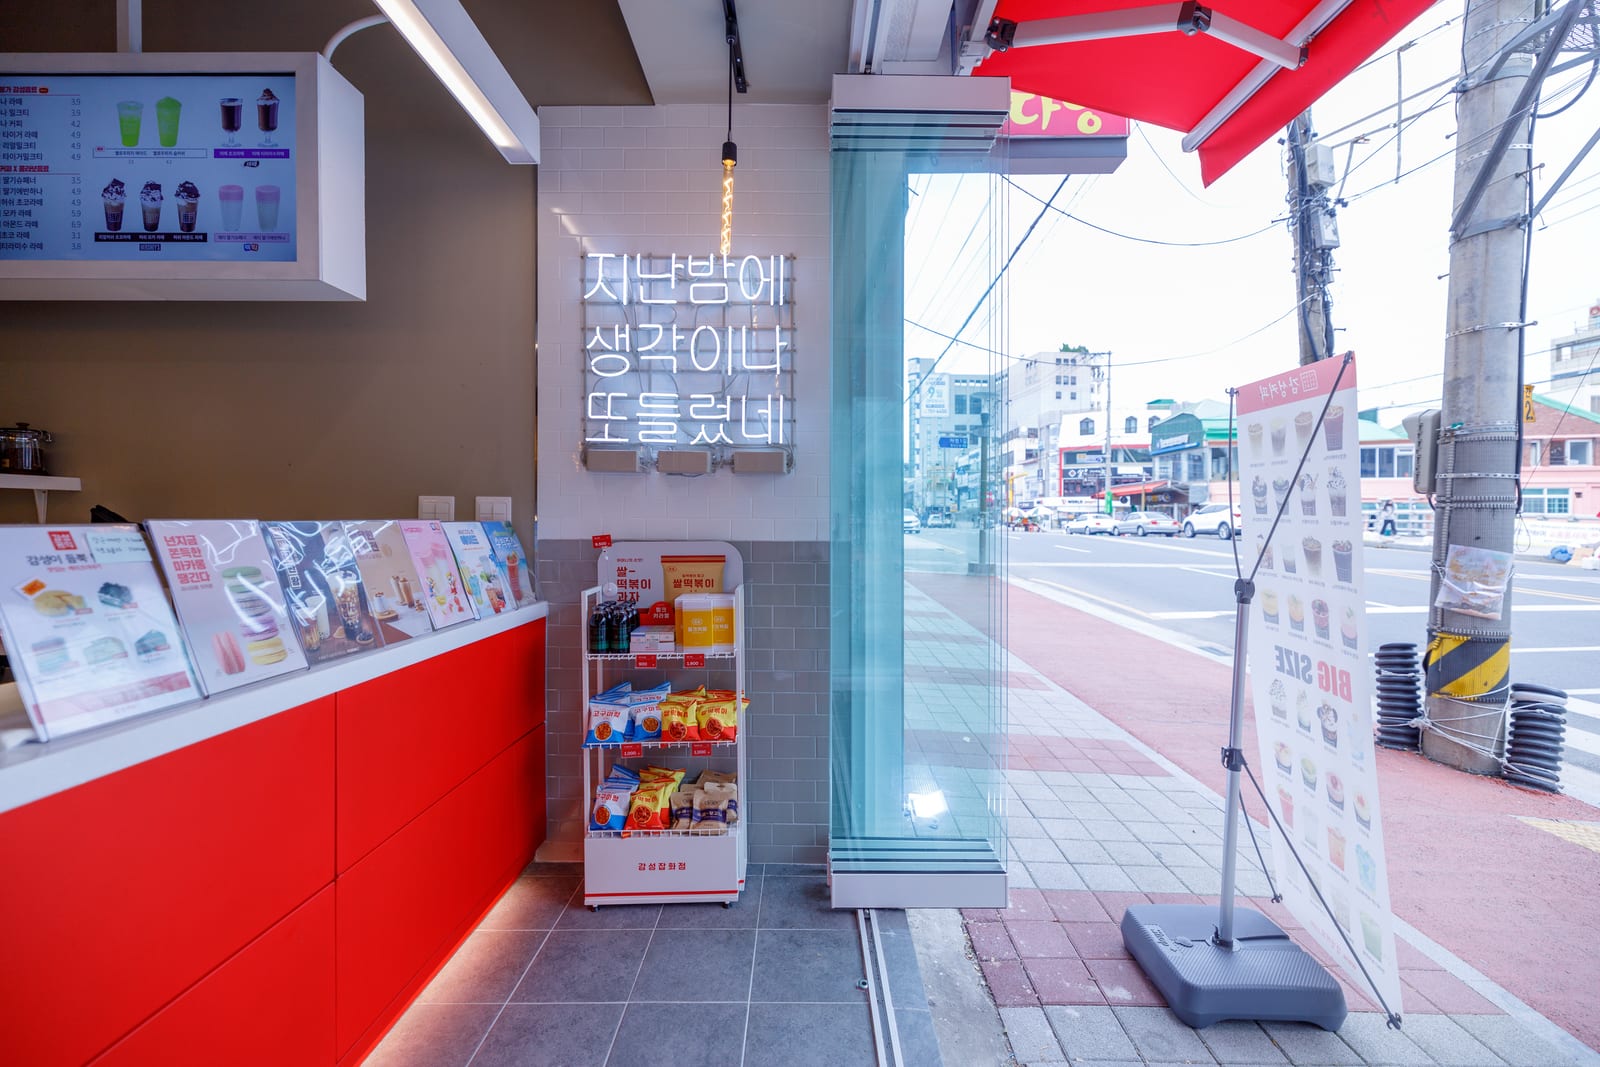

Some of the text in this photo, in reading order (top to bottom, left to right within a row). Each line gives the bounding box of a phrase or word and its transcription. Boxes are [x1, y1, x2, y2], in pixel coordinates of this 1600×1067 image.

[583, 252, 785, 306] 지난밤에
[585, 323, 789, 377] 생각이나
[163, 534, 198, 547] 넌지금
[172, 559, 207, 571] 마카롱
[616, 578, 651, 590] 떡볶이
[673, 578, 715, 590] 쌀떡볶이
[616, 591, 640, 603] 과자
[638, 862, 686, 871] 감성잡화점
